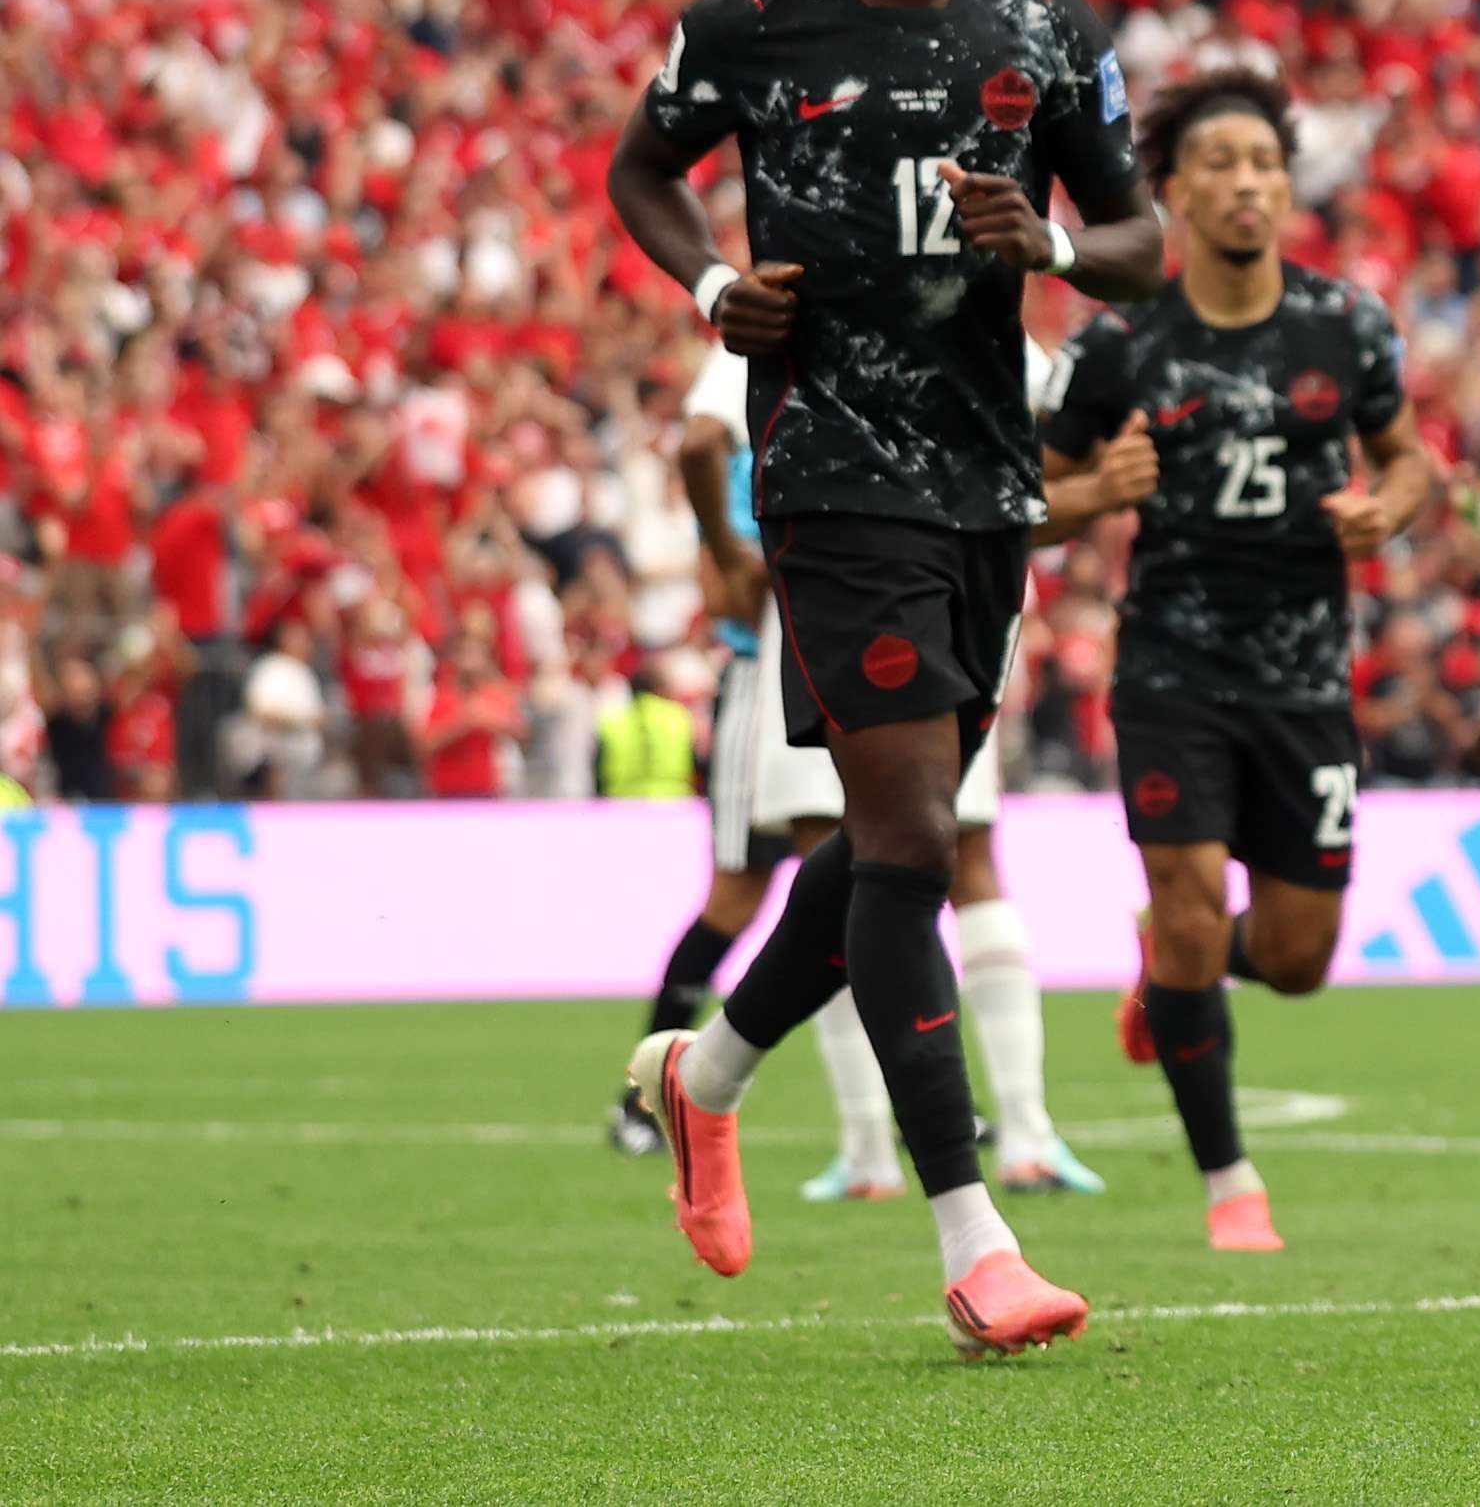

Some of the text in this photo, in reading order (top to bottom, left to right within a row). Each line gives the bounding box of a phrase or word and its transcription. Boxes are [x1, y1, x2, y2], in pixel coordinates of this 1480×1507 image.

[891, 156, 962, 256] 12
[1214, 434, 1288, 519] 25
[1311, 762, 1358, 848] 2
